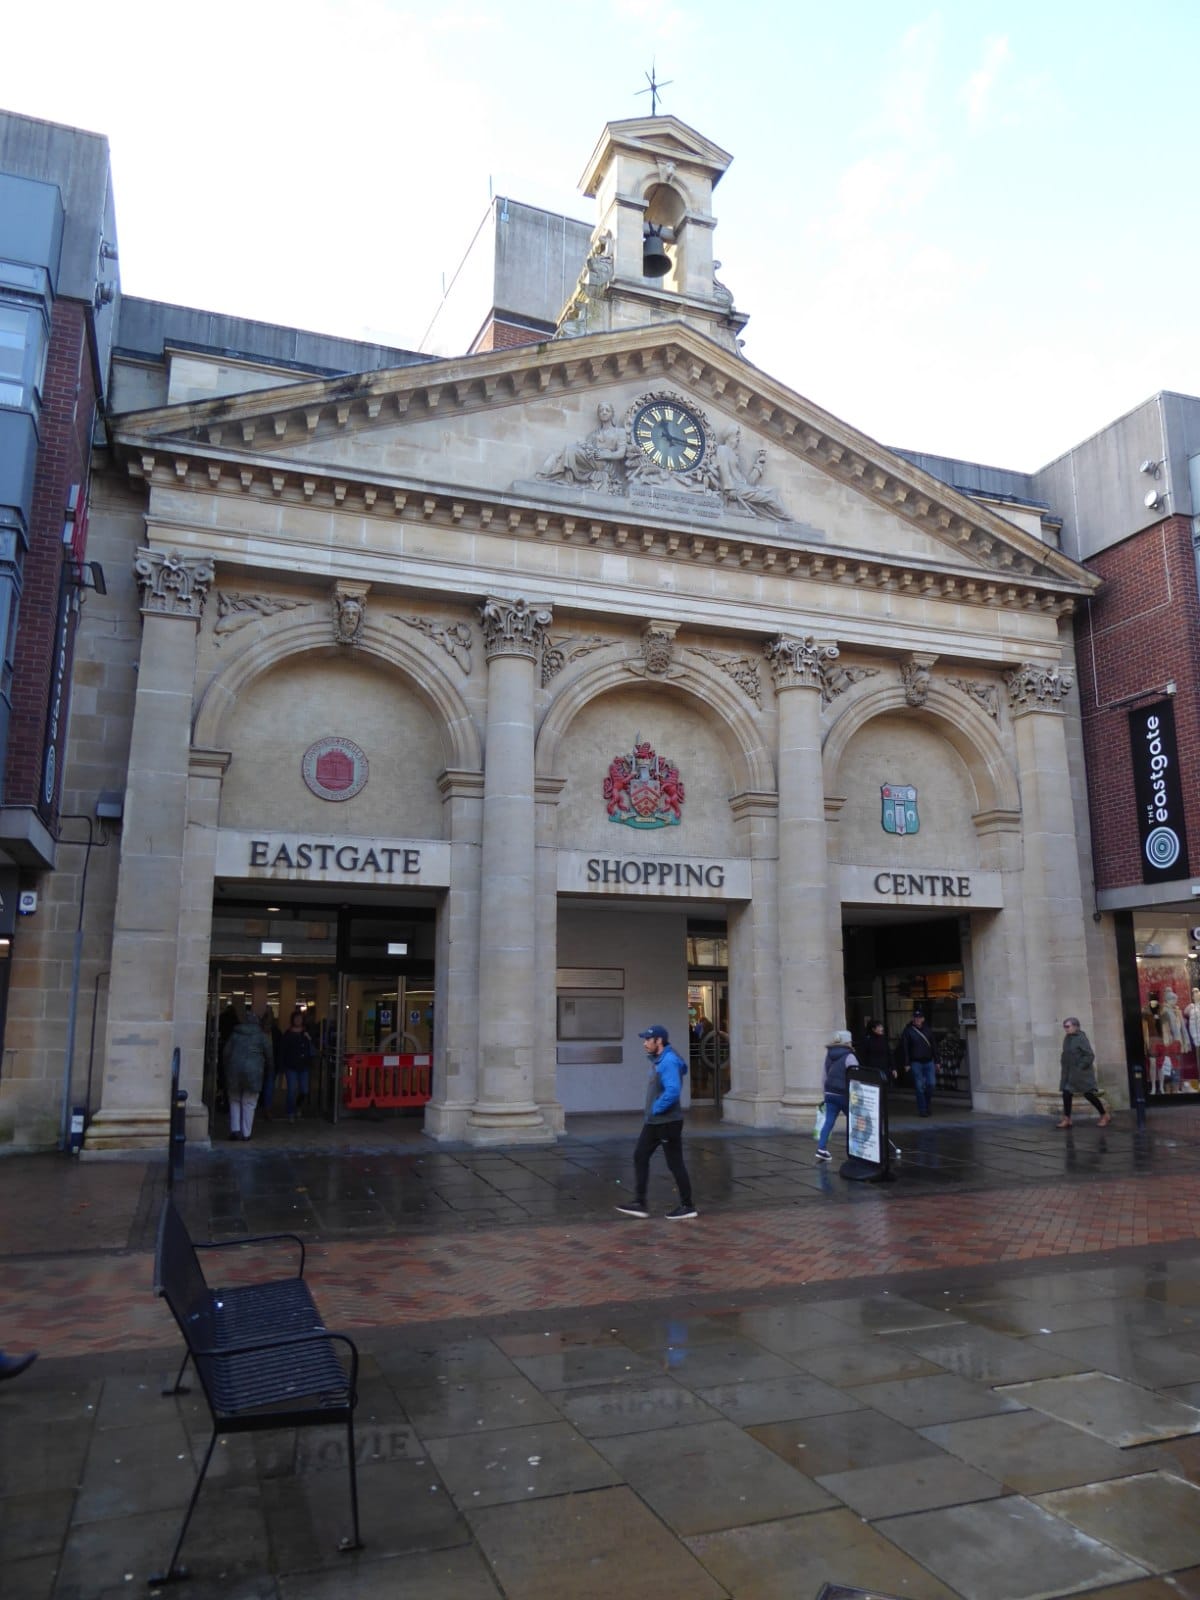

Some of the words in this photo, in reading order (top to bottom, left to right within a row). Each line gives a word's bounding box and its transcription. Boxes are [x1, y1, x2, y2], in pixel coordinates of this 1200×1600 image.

[1146, 715, 1168, 822] eastgate
[249, 841, 421, 874] EASTGATE
[587, 858, 725, 888] SHOPPING
[874, 872, 972, 897] CENTRE
